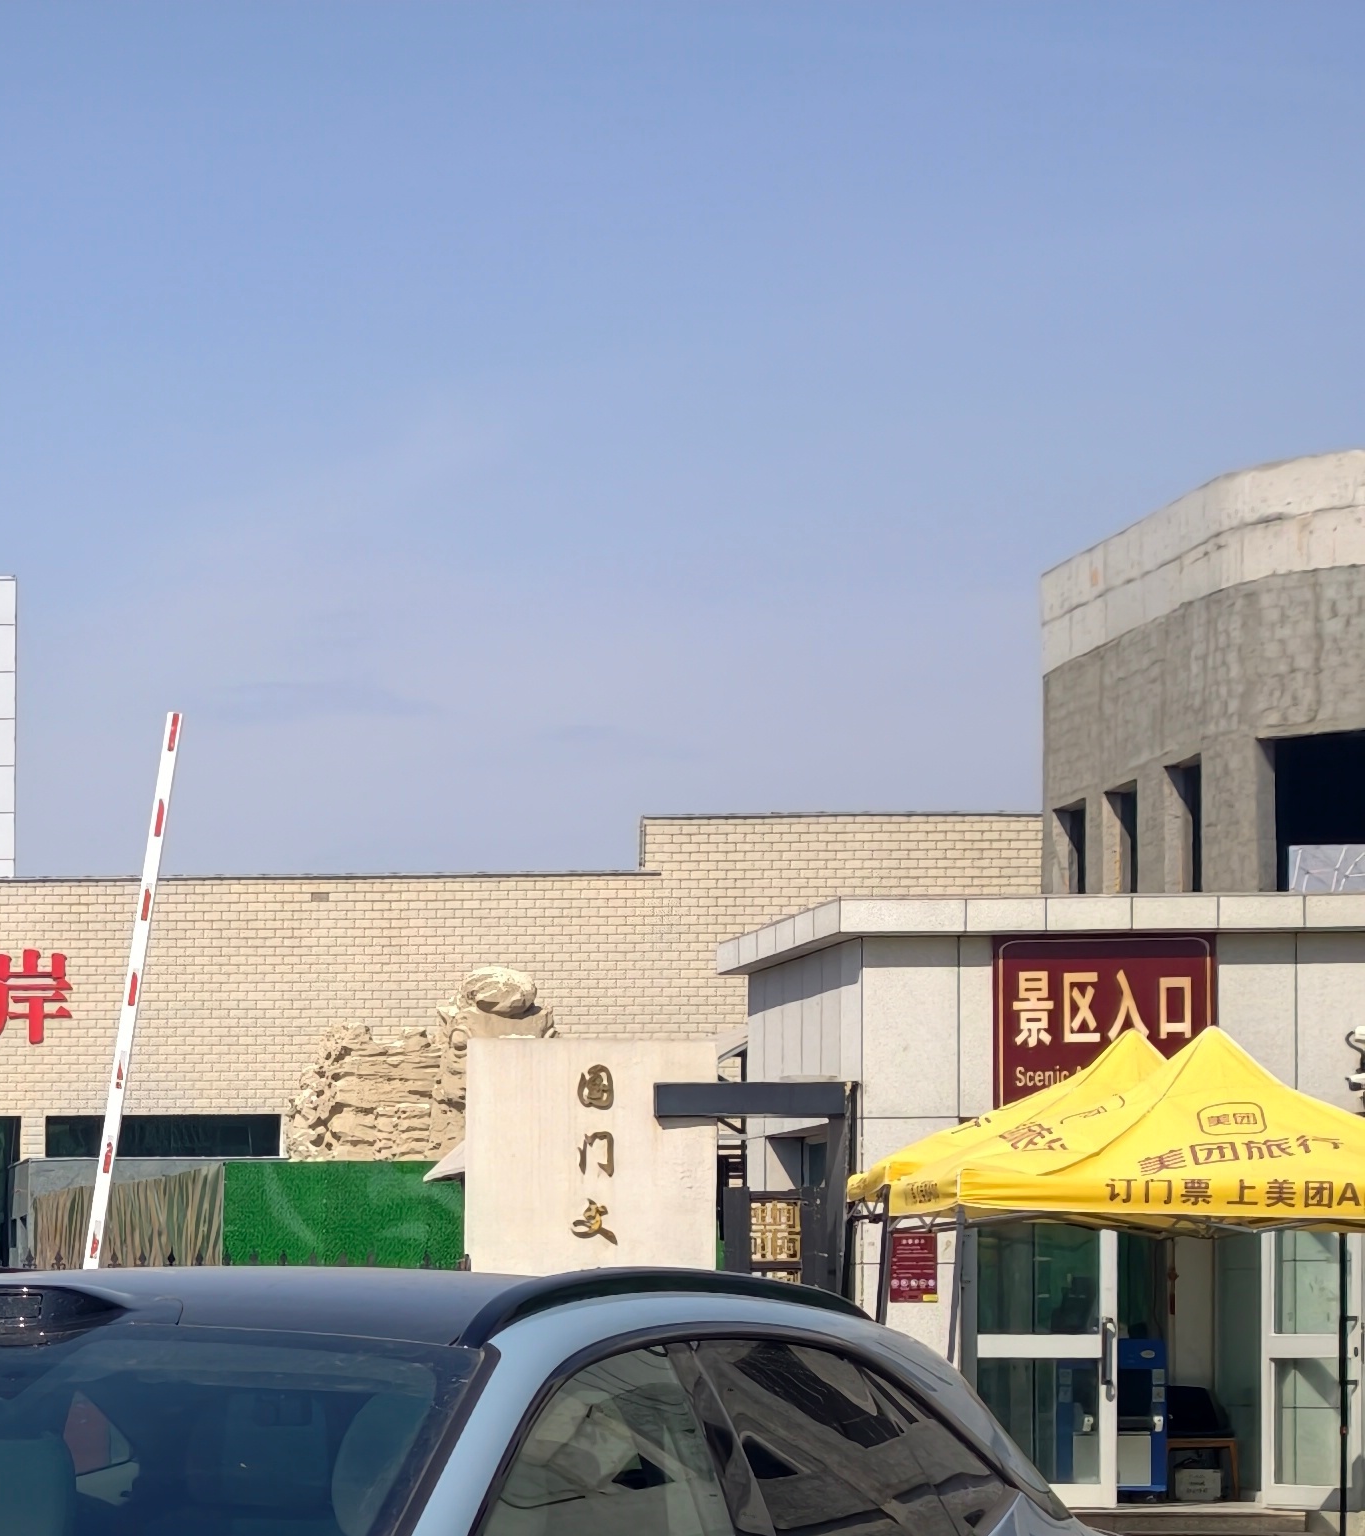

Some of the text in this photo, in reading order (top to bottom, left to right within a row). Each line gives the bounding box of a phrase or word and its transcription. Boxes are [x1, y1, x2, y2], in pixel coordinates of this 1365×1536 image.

[1012, 969, 1192, 1047] 景区入口
[1015, 1066, 1070, 1088] Scenic
[1207, 1112, 1258, 1127] 美团
[1137, 1135, 1344, 1177] 美团旅行
[1105, 1178, 1365, 1209] 订门票 上美团A
